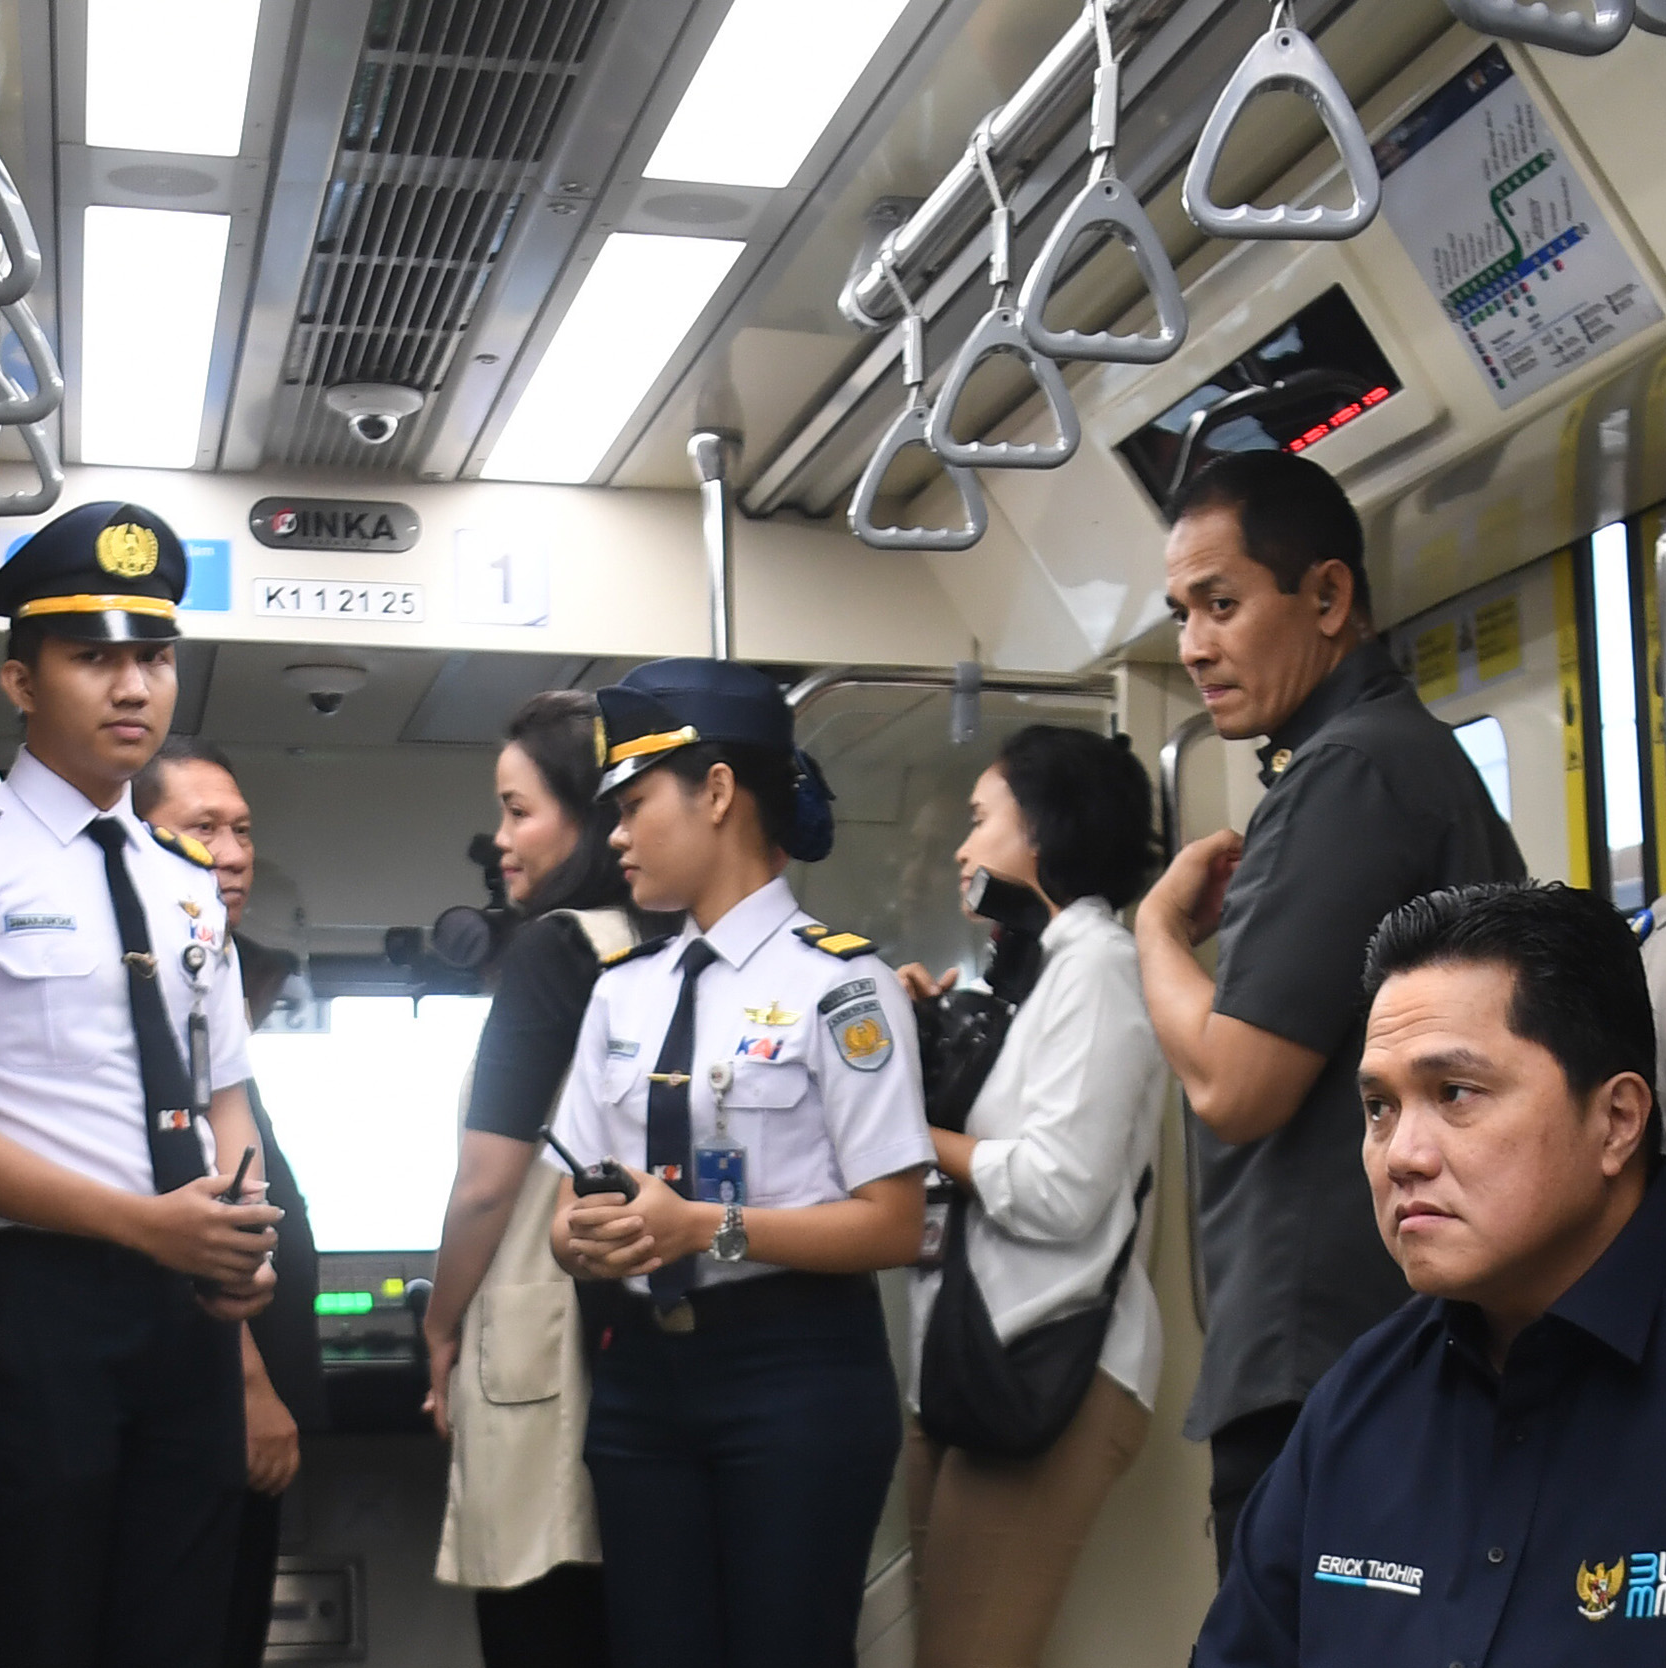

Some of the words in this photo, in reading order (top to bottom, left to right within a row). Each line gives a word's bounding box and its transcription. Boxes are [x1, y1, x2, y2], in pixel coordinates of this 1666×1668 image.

[301, 510, 397, 541] INKA
[489, 554, 513, 604] 1
[381, 591, 416, 615] 25
[1317, 1554, 1365, 1577] ERICK
[1366, 1560, 1424, 1586] THOHIR
